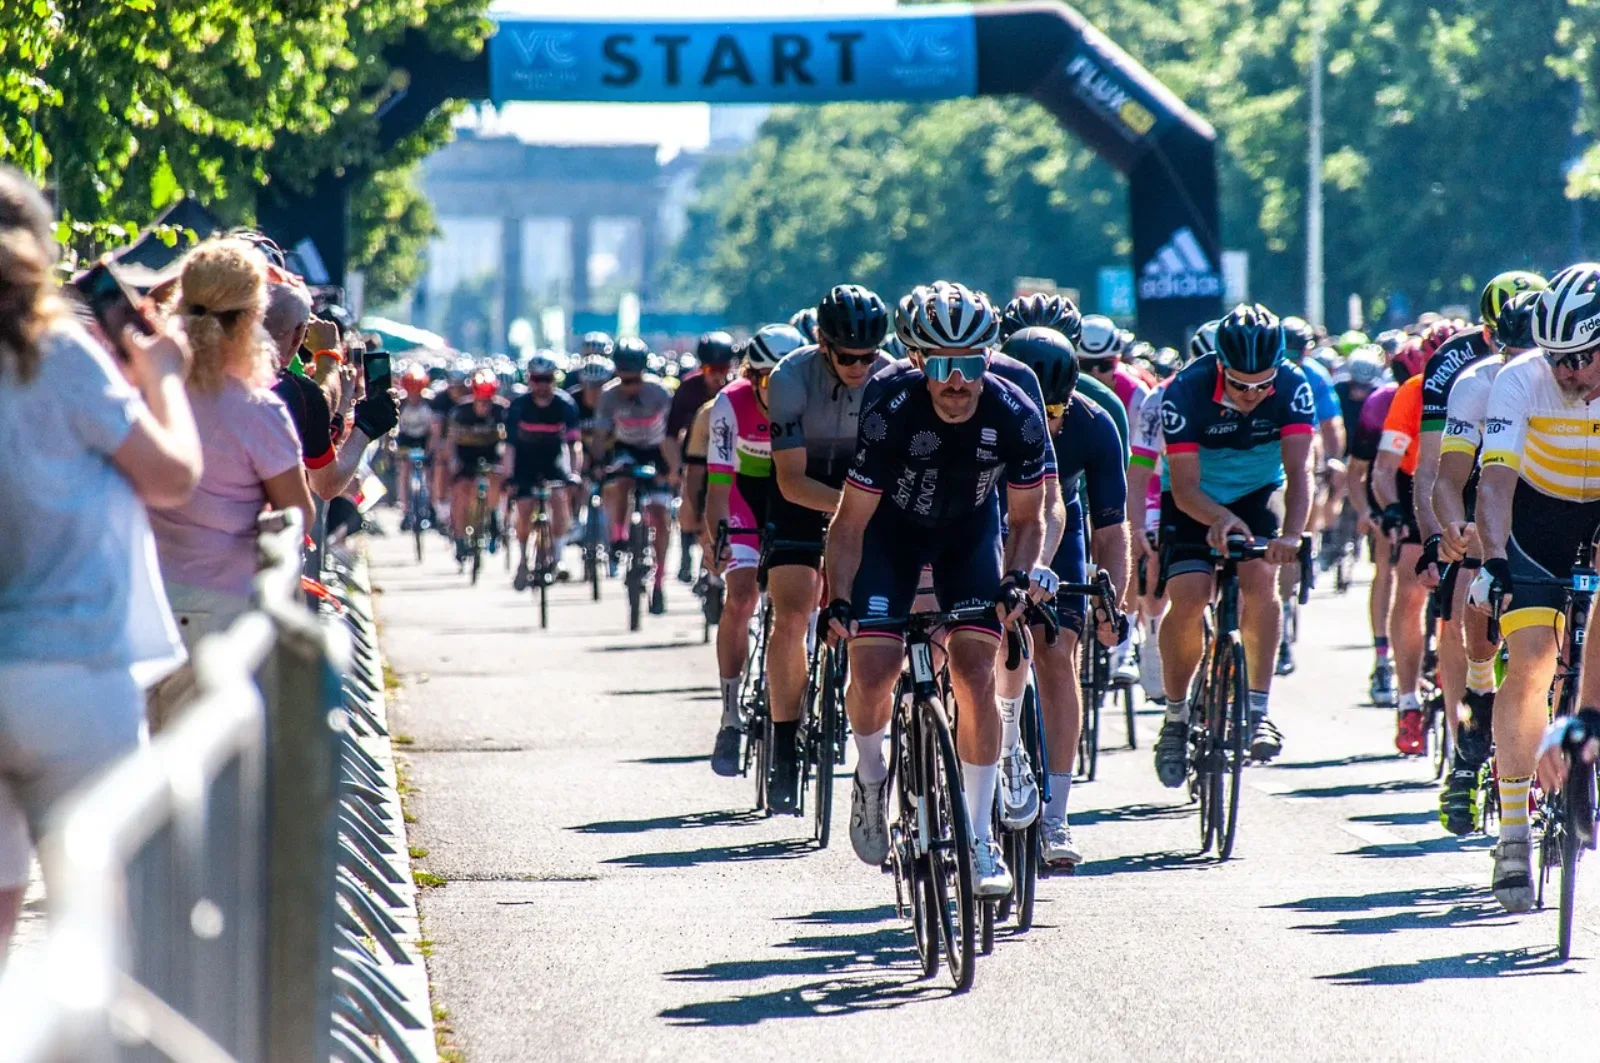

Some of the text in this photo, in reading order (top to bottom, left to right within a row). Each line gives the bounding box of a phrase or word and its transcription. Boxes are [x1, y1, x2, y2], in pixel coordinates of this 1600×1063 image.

[602, 31, 864, 87] START
[1139, 272, 1221, 300] adidas
[889, 391, 909, 411] CLIF
[1002, 393, 1022, 413] CLIF
